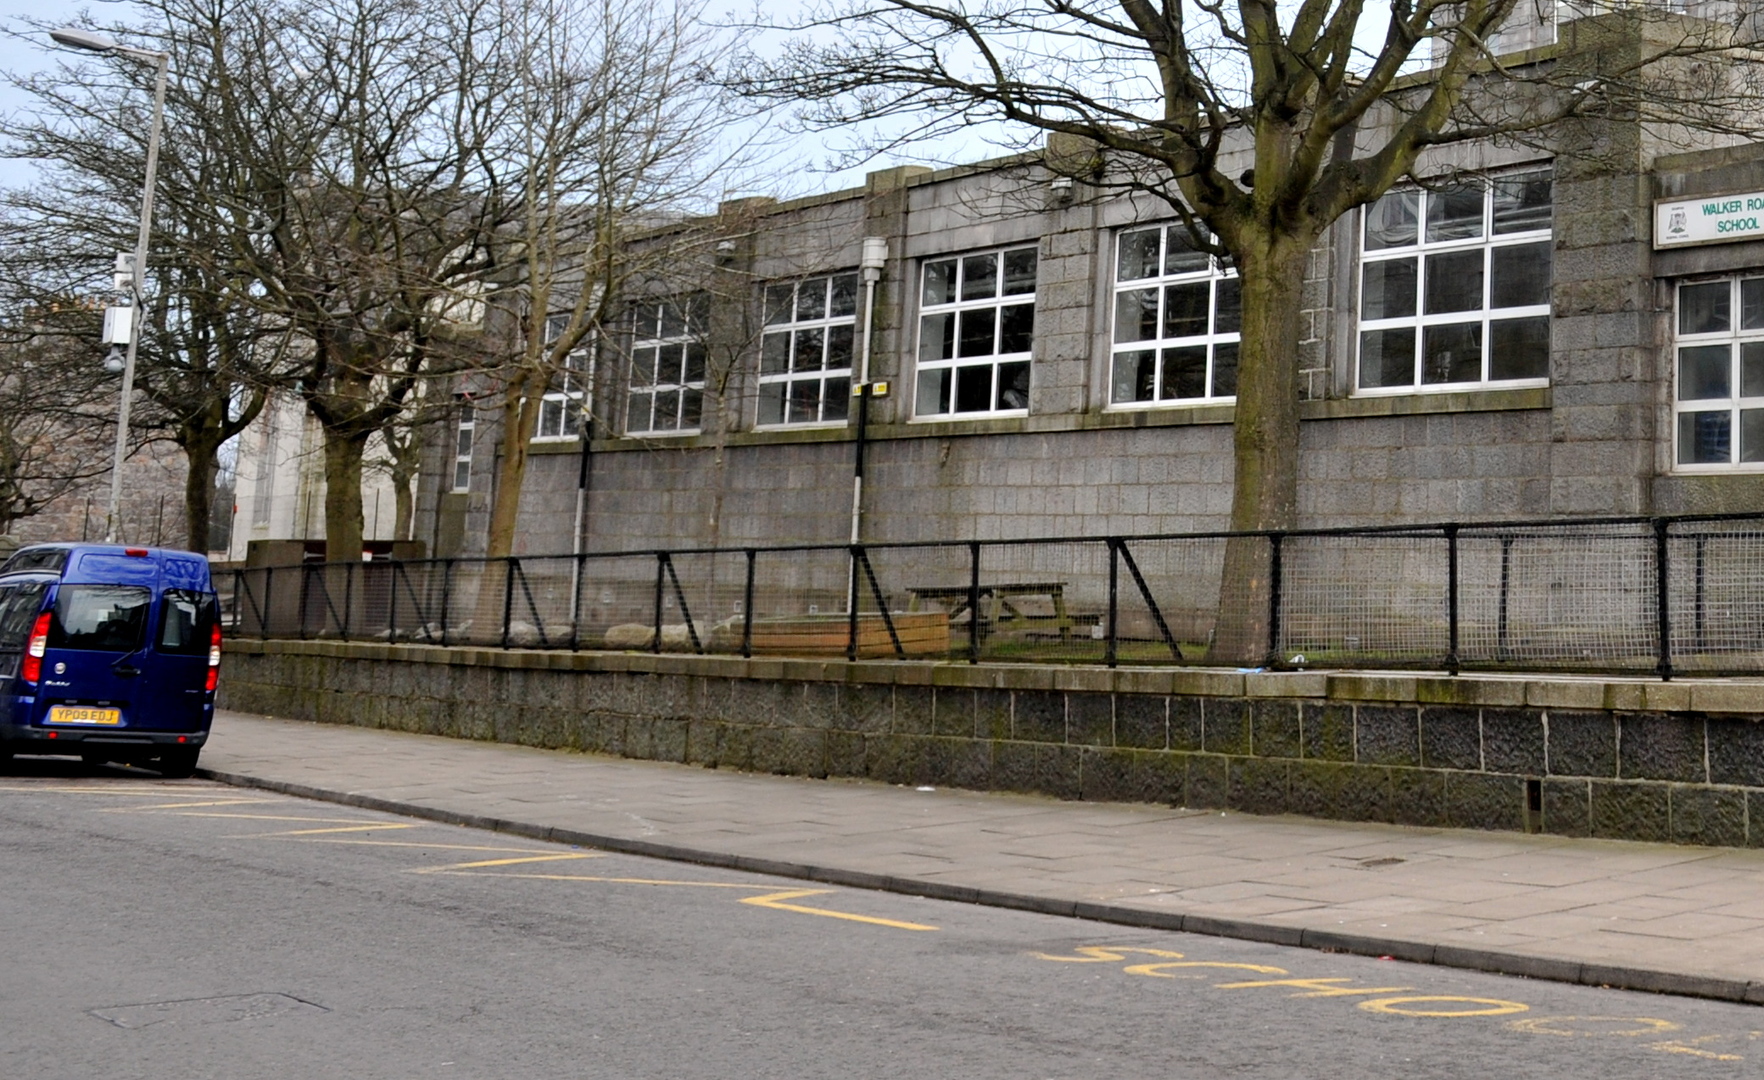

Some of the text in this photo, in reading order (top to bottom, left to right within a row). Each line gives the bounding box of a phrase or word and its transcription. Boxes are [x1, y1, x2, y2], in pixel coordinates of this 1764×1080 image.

[1702, 200, 1742, 216] WALKER
[1717, 217, 1760, 233] SCHOOL
[57, 709, 87, 721] YP09
